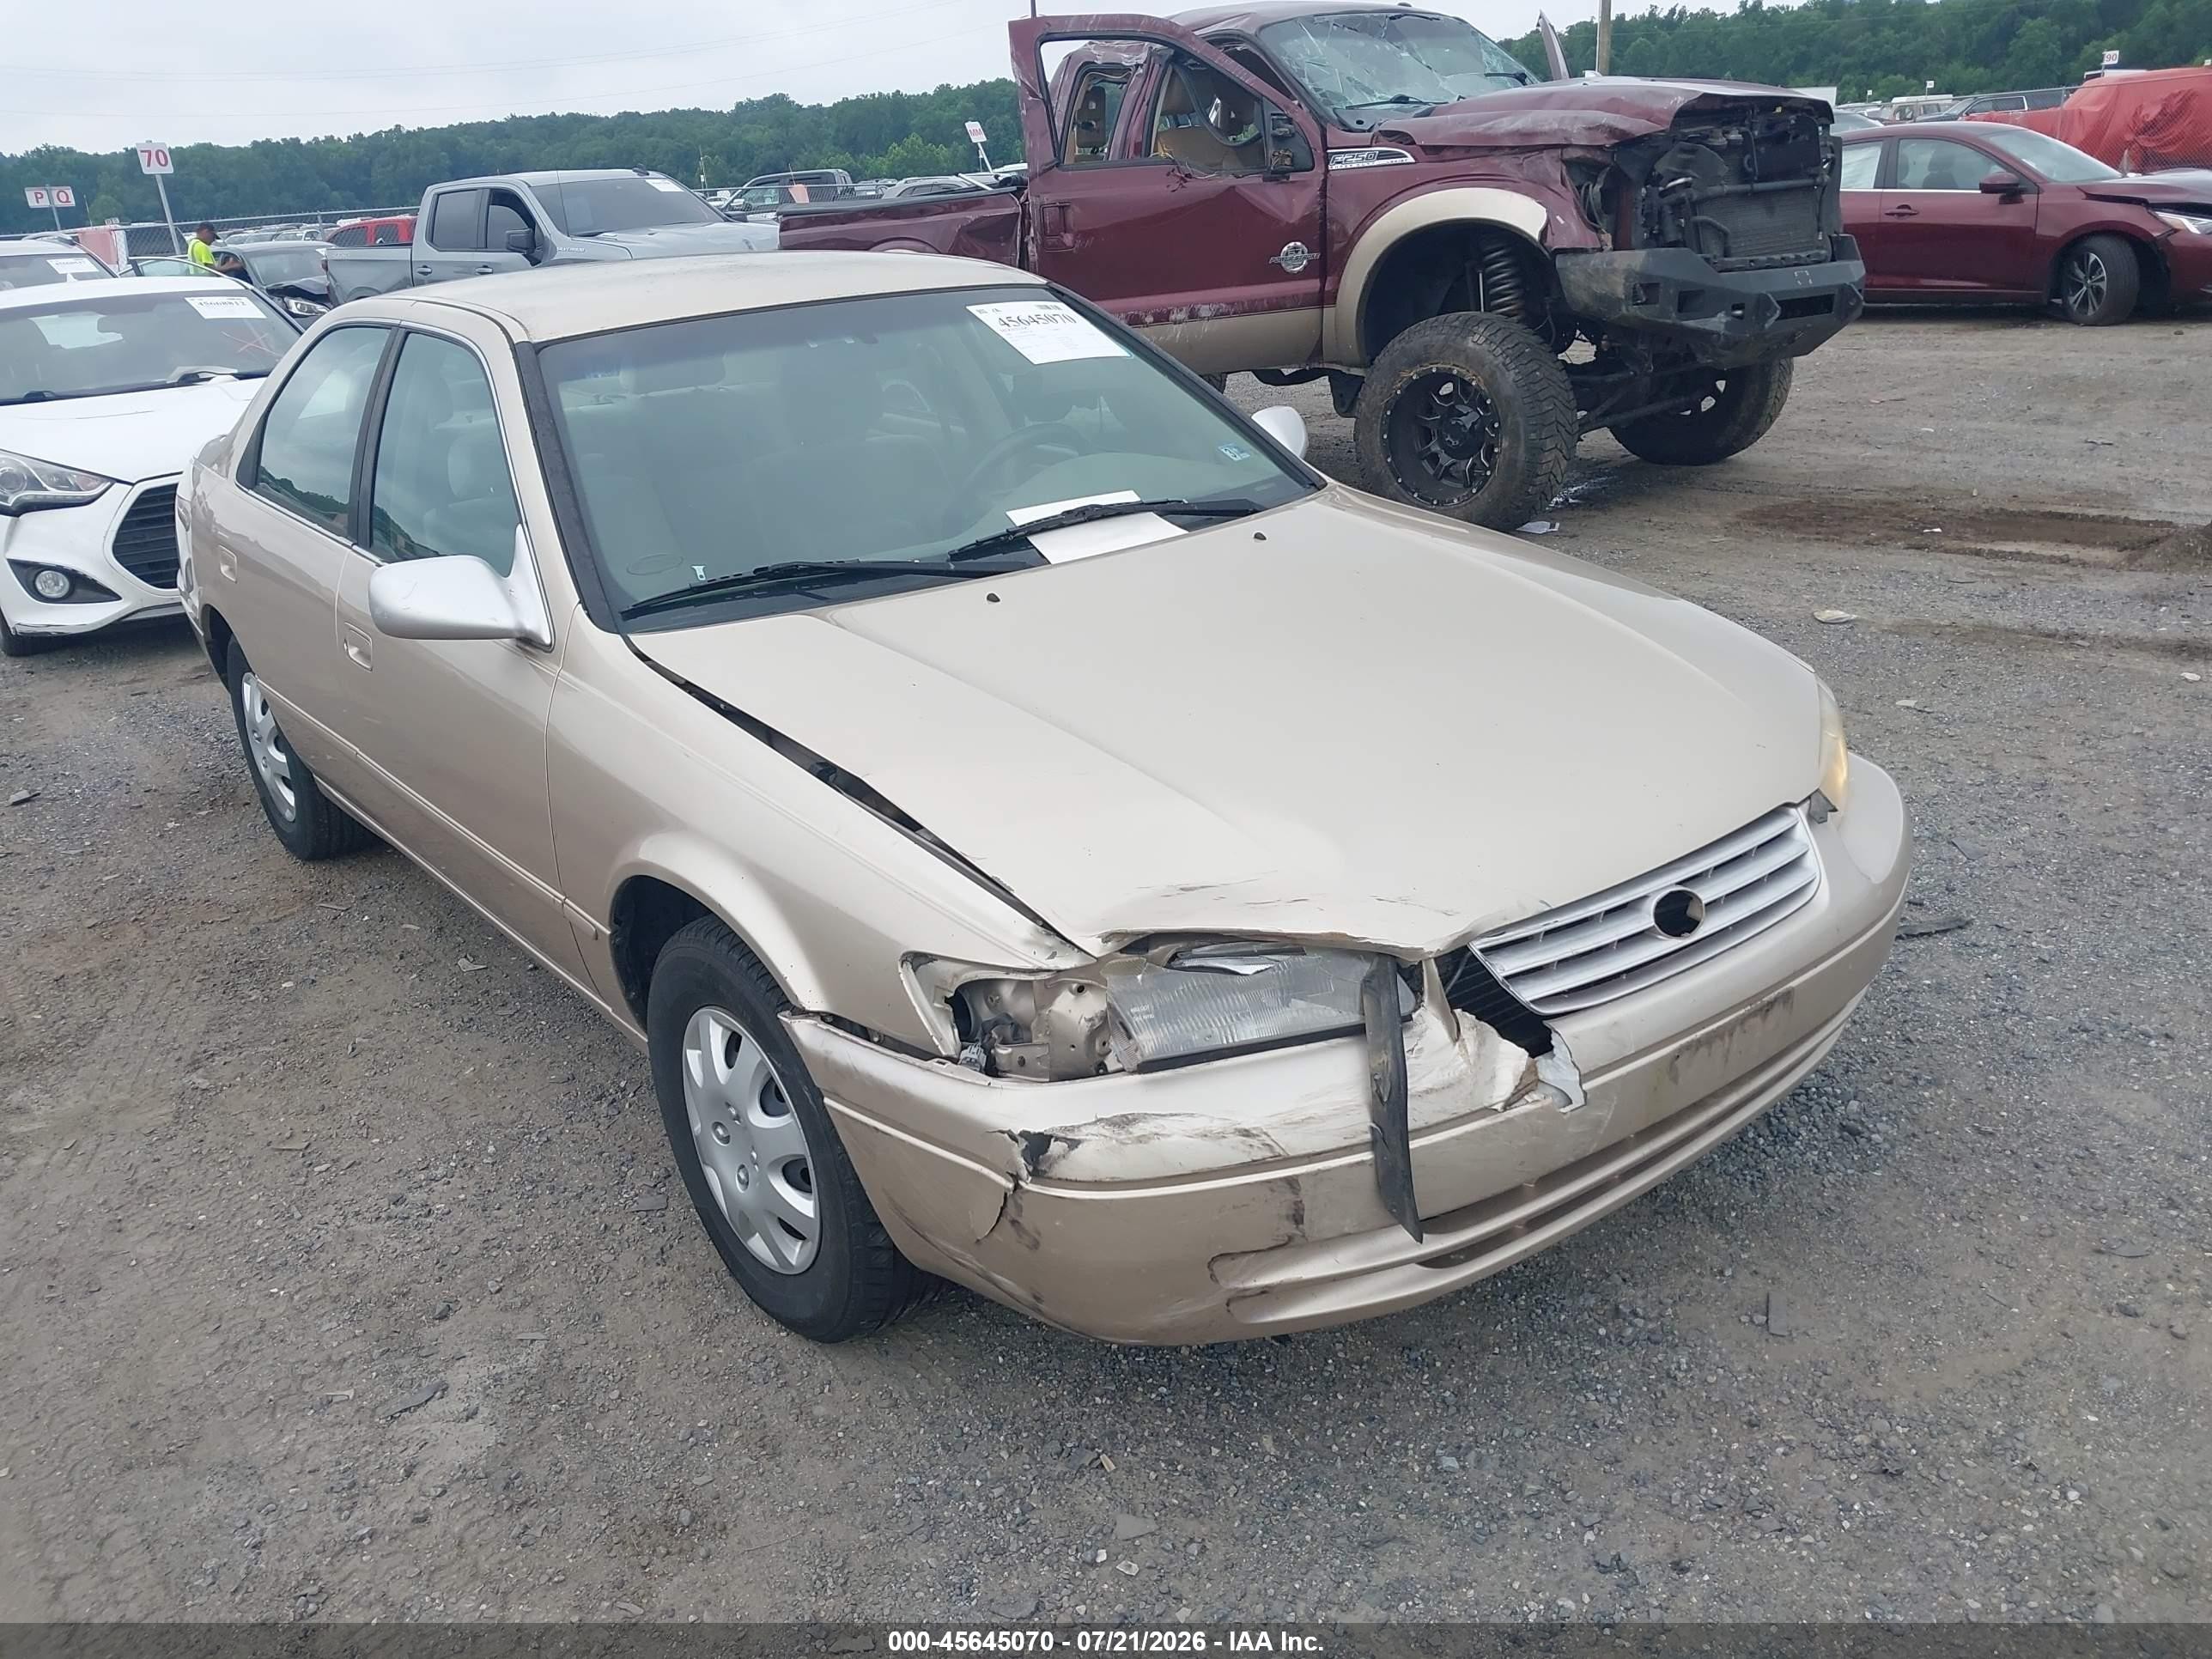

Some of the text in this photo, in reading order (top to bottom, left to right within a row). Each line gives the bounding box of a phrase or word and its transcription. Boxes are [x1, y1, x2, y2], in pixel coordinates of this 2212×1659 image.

[2106, 53, 2118, 62] 90
[140, 149, 169, 168] 70
[33, 190, 71, 204] P Q
[997, 313, 1077, 329] 45645070
